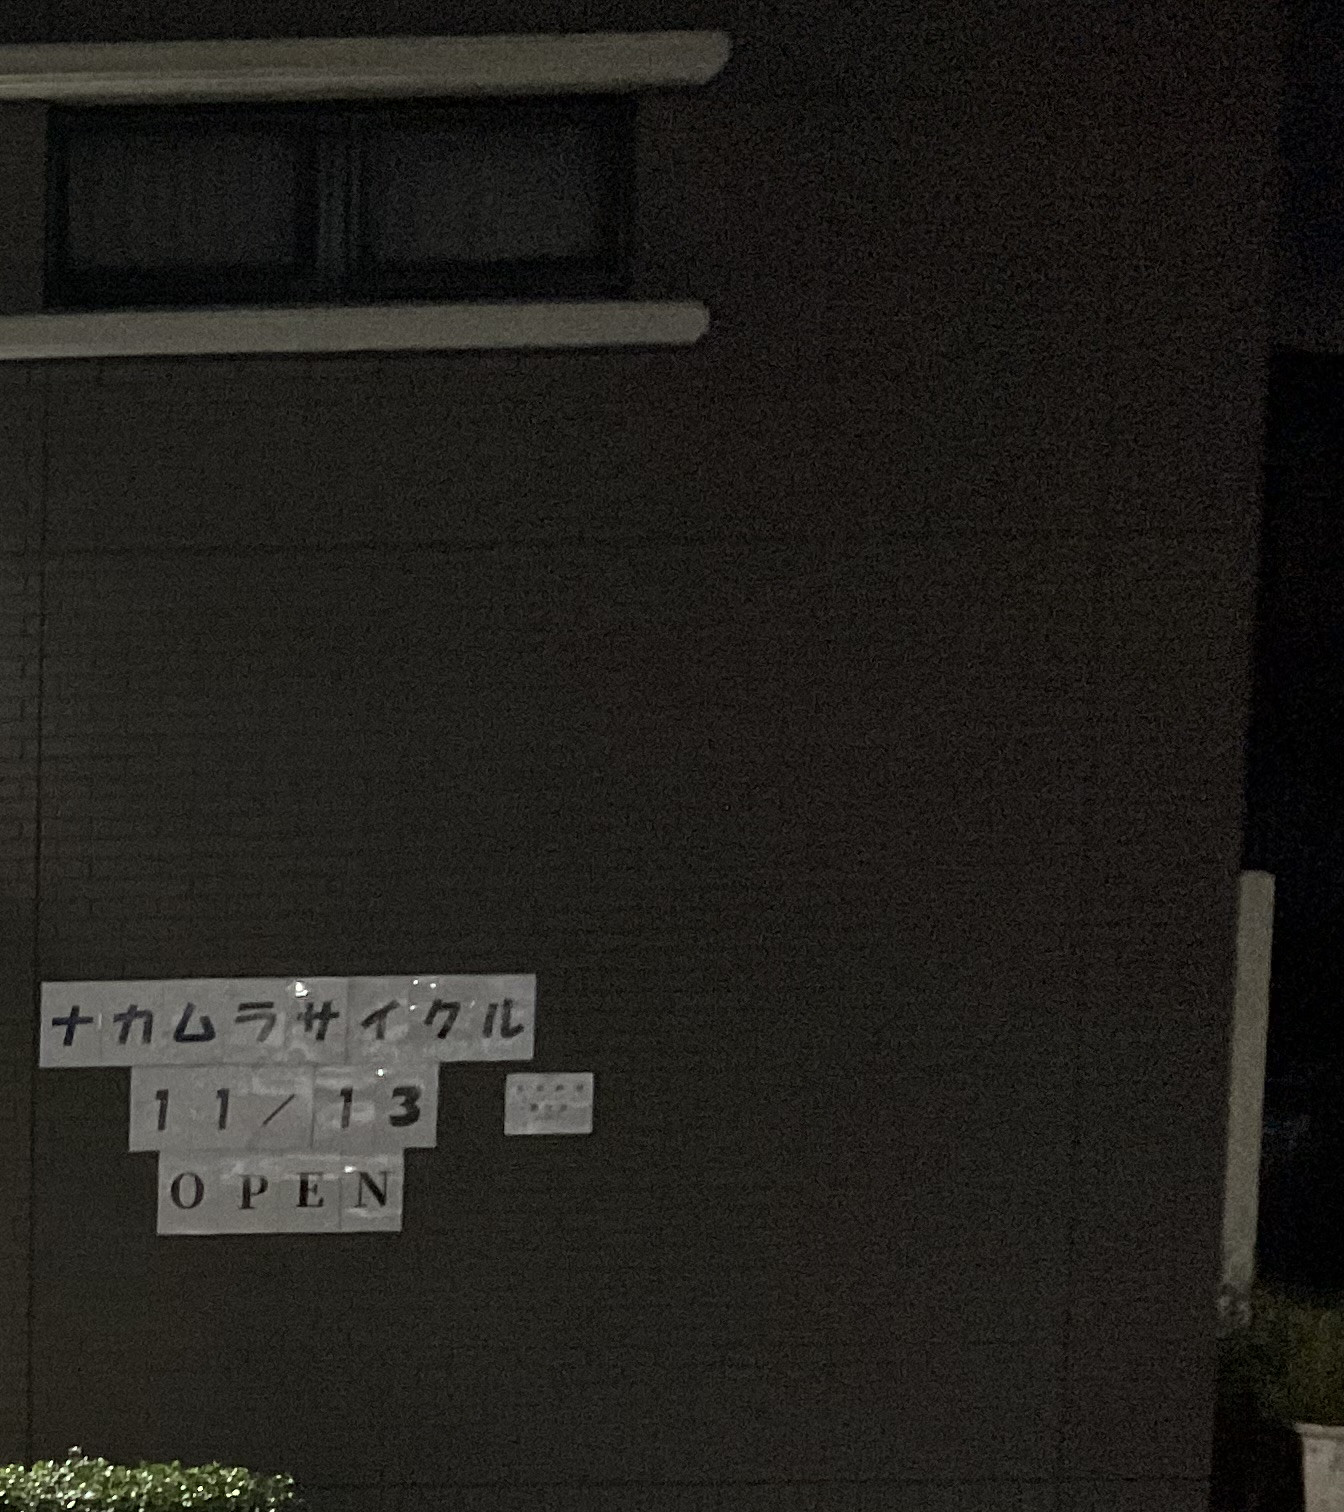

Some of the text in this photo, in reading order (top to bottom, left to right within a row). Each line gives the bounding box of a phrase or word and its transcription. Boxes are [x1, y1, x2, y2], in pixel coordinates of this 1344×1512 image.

[51, 997, 526, 1048] ナカムラサイクル
[170, 1170, 389, 1210] OPEN
